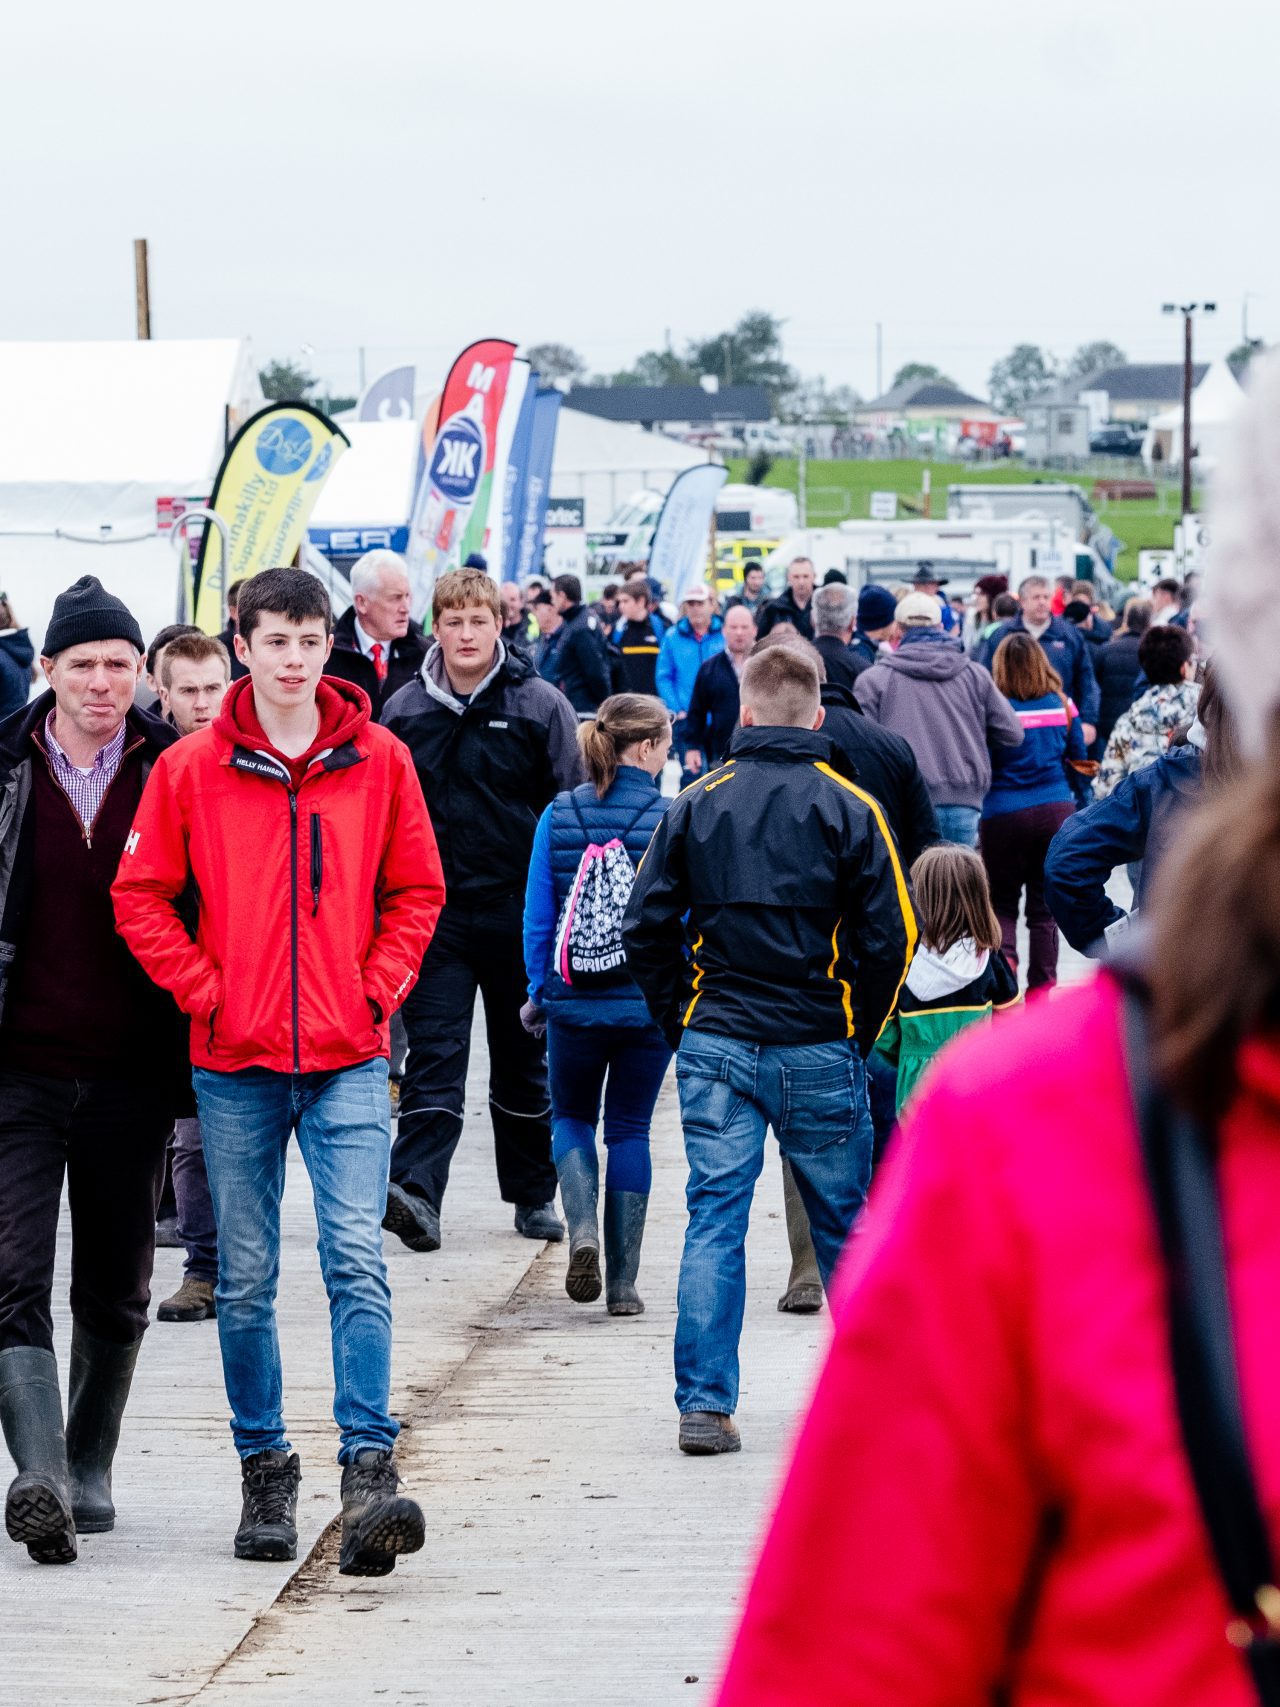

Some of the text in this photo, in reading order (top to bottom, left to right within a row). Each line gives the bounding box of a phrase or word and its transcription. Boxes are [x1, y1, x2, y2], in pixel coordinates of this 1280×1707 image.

[236, 758, 284, 778] HELLY HANSEN
[572, 942, 623, 957] FREELAND
